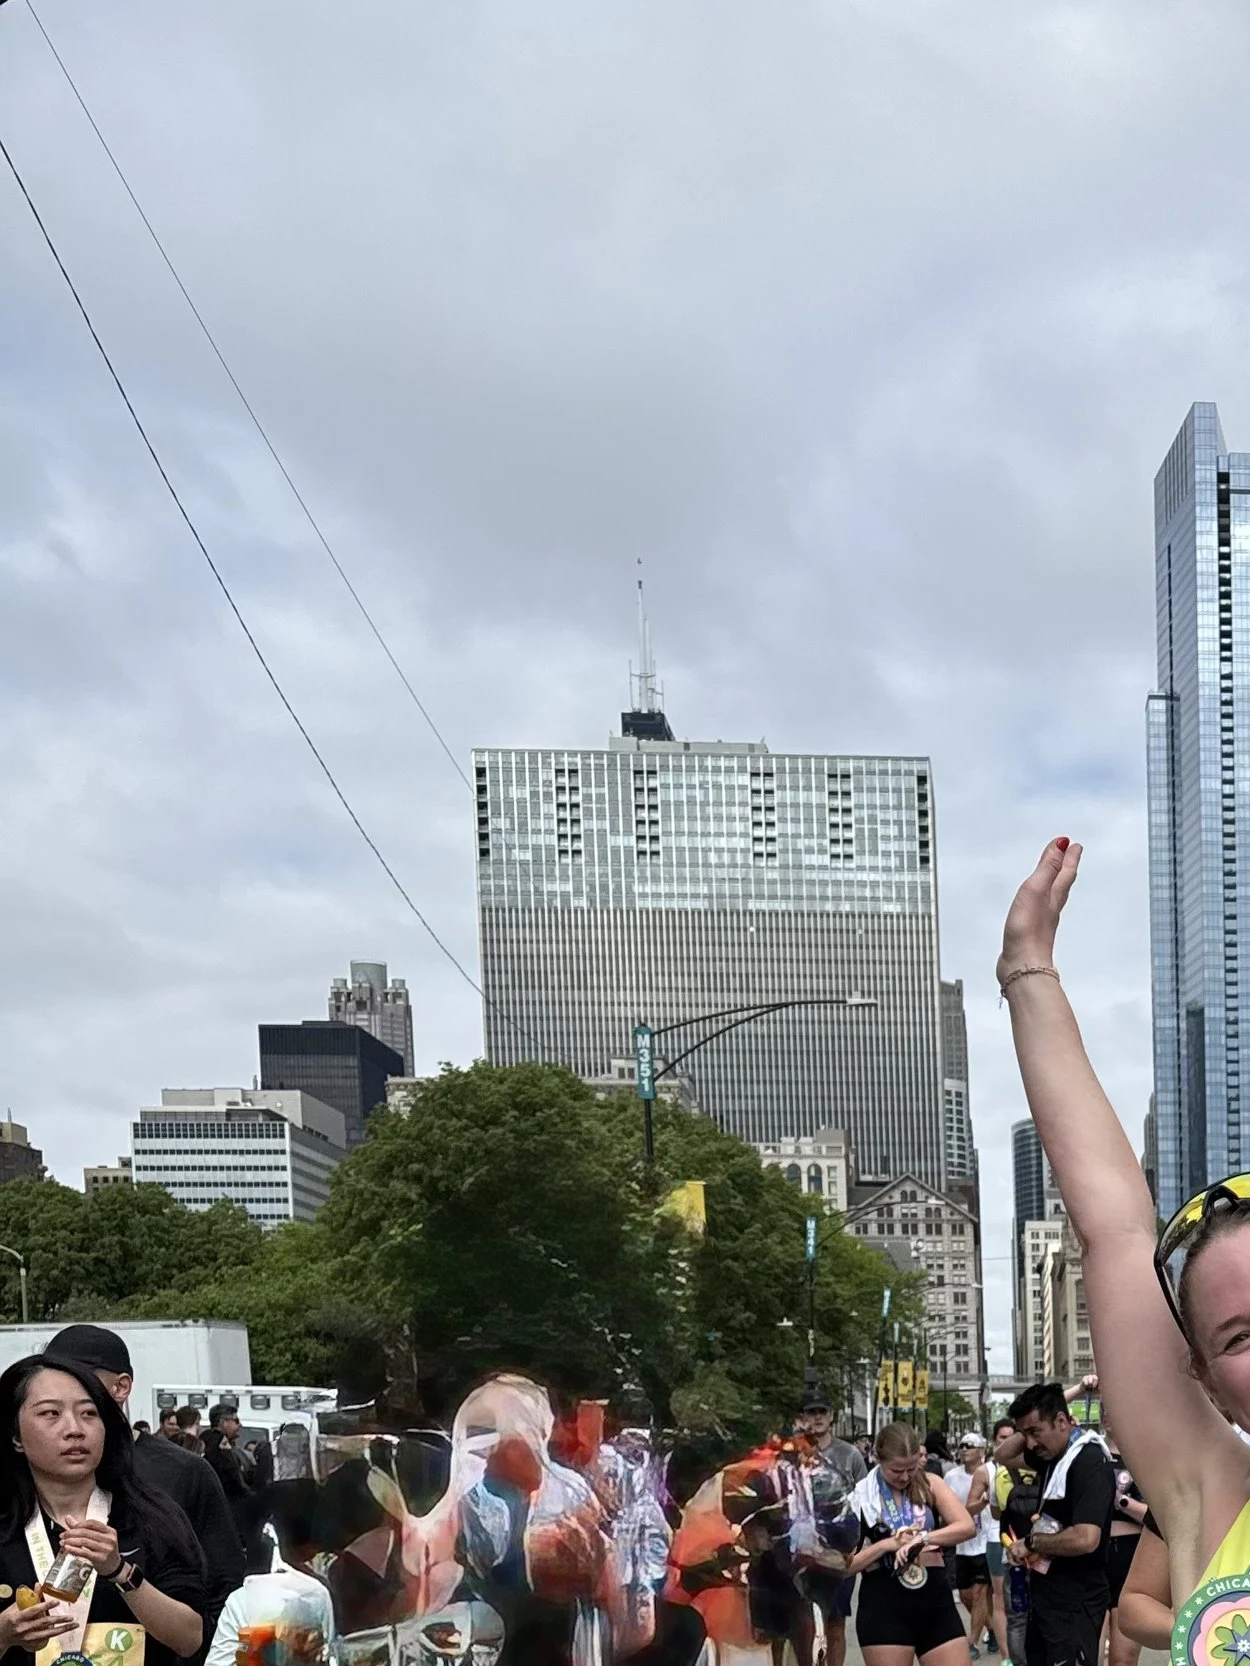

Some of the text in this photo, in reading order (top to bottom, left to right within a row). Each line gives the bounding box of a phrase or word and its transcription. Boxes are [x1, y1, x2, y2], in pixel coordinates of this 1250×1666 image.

[636, 1033, 651, 1092] M351
[110, 1630, 128, 1651] K
[56, 1654, 85, 1665] CHICAGO
